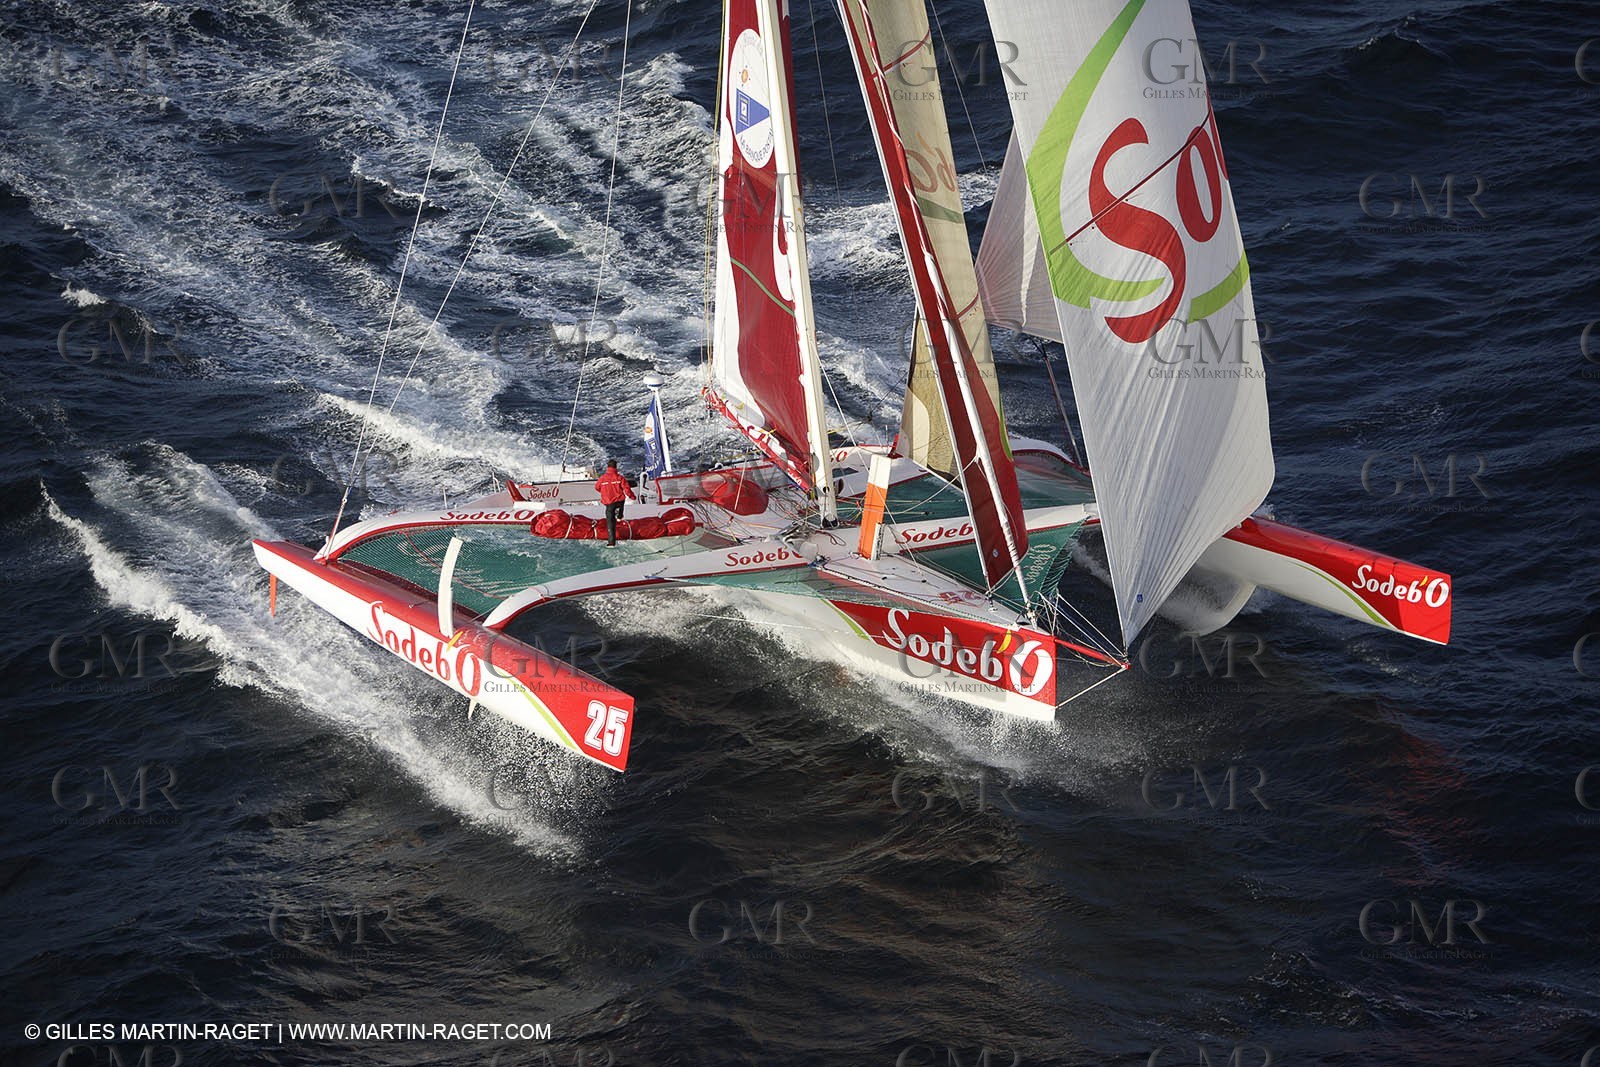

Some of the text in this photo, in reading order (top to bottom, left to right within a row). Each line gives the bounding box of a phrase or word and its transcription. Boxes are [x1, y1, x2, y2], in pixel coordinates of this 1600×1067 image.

[895, 523, 974, 544] Sodeb
[1352, 564, 1449, 608] Sodeb'O
[368, 600, 482, 697] Sodeb'O
[882, 608, 1054, 696] Sodeb'O
[583, 699, 629, 757] 25
